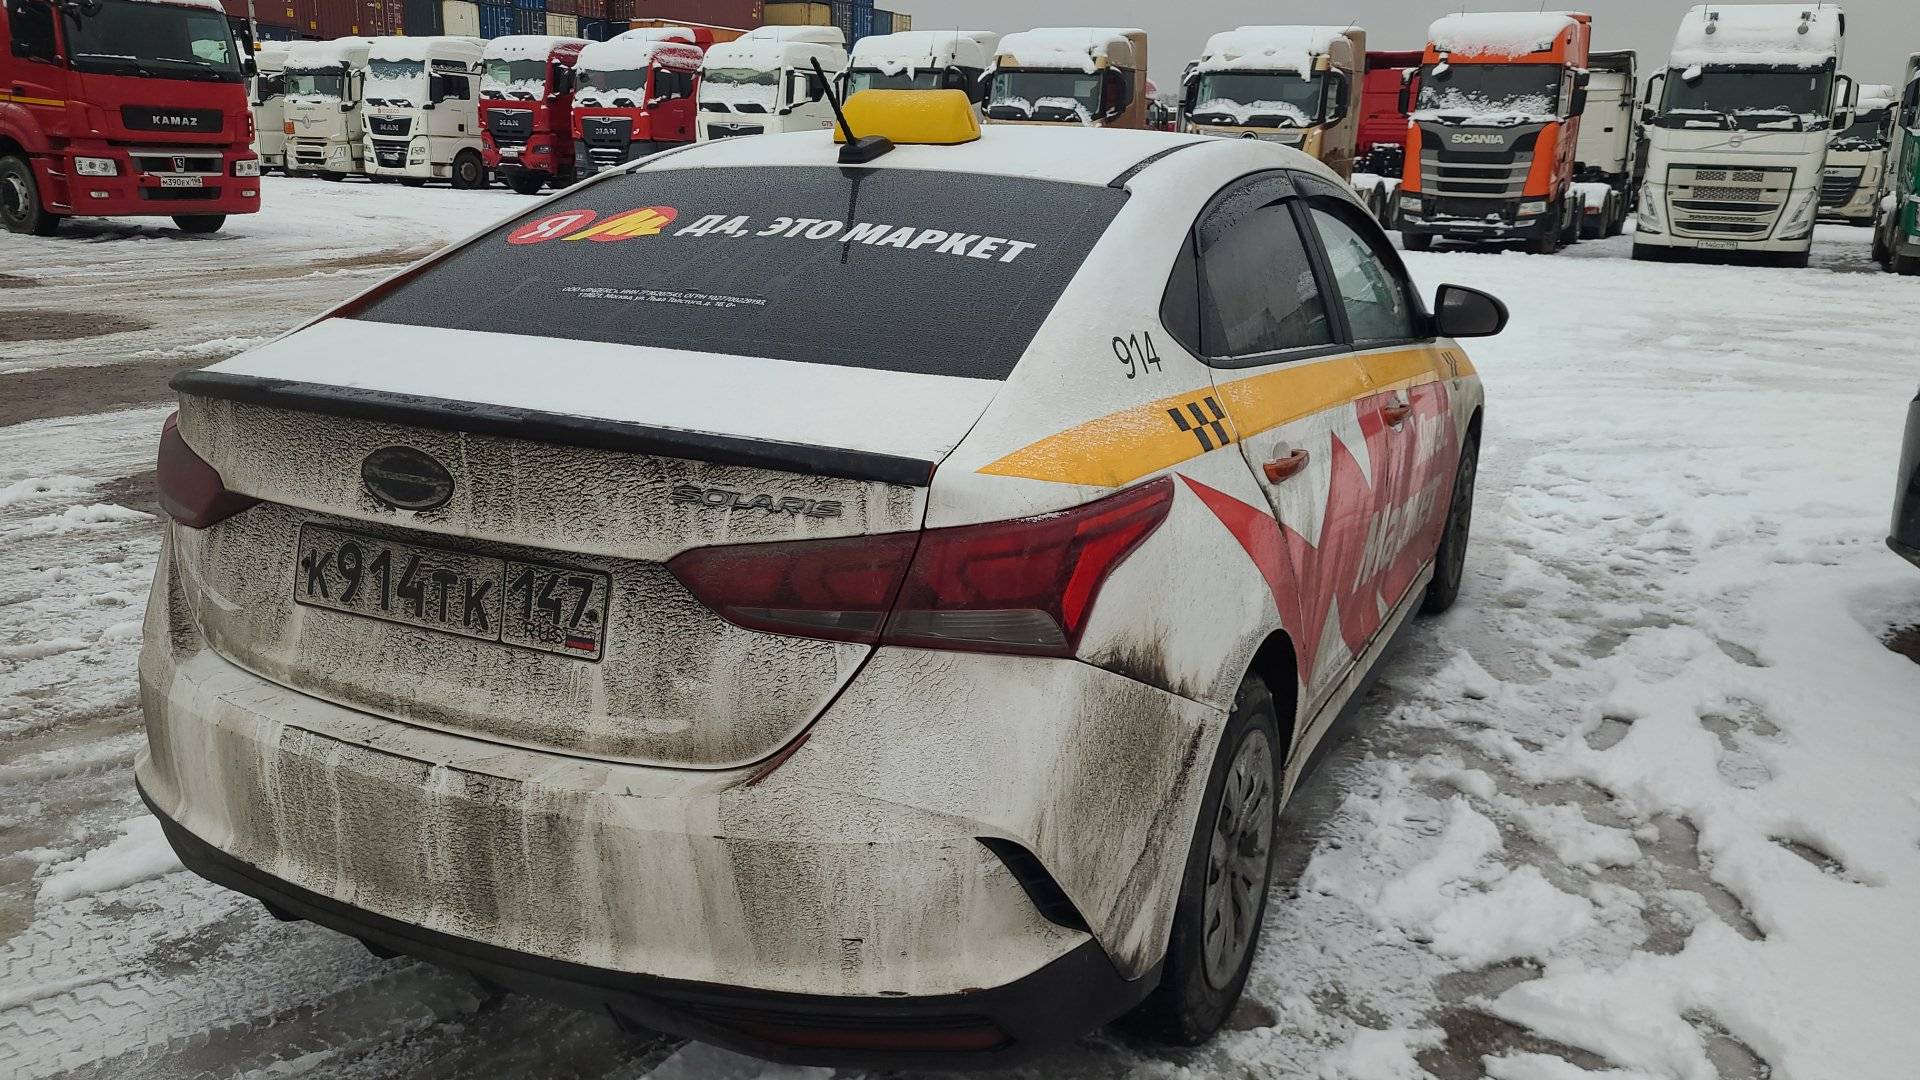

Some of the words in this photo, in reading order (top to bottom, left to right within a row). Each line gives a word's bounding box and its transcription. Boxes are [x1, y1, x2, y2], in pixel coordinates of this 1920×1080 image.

[152, 115, 198, 126] KAMAZ
[1451, 133, 1504, 144] SCANIA
[672, 214, 750, 238] ДА,
[755, 216, 844, 240] ЭТО
[837, 222, 1037, 263] МАРКЕТ
[1112, 331, 1162, 379] 914
[668, 484, 845, 517] SOLARIS
[512, 569, 594, 629] 147
[524, 622, 566, 645] RUS
